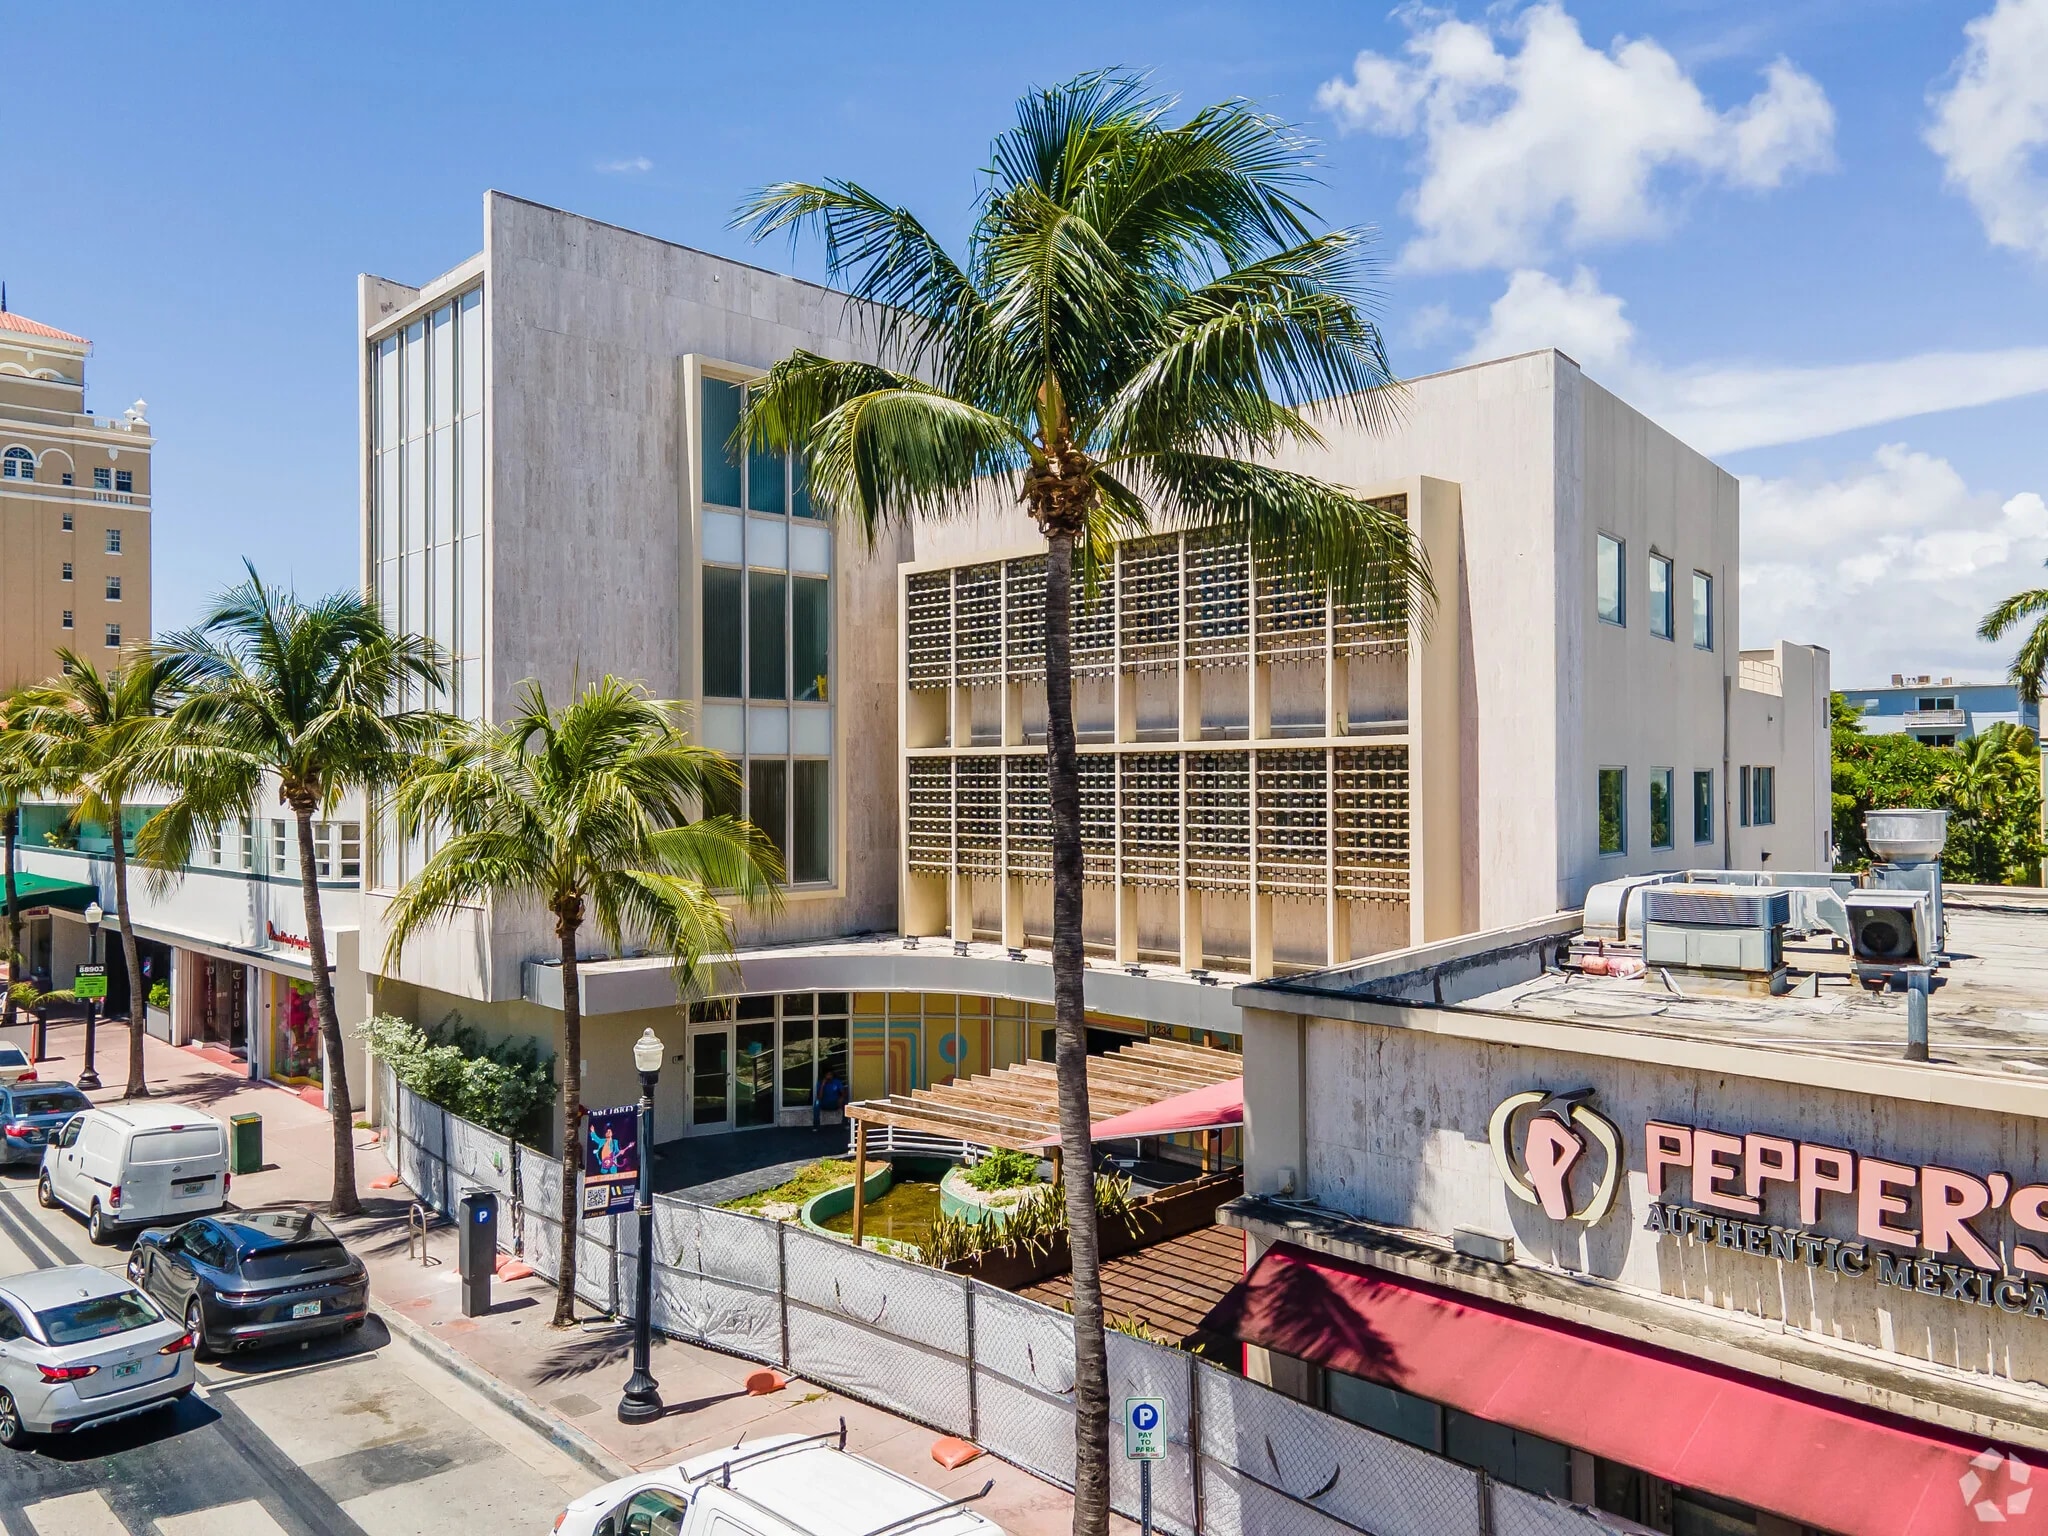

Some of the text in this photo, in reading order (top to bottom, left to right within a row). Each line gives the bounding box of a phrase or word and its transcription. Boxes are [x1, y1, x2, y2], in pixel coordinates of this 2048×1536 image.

[79, 965, 104, 973] 88903
[1644, 1118, 2048, 1276] PEPPER'S
[1643, 1200, 1868, 1279] AUTHENTIC
[1139, 1408, 1153, 1426] P
